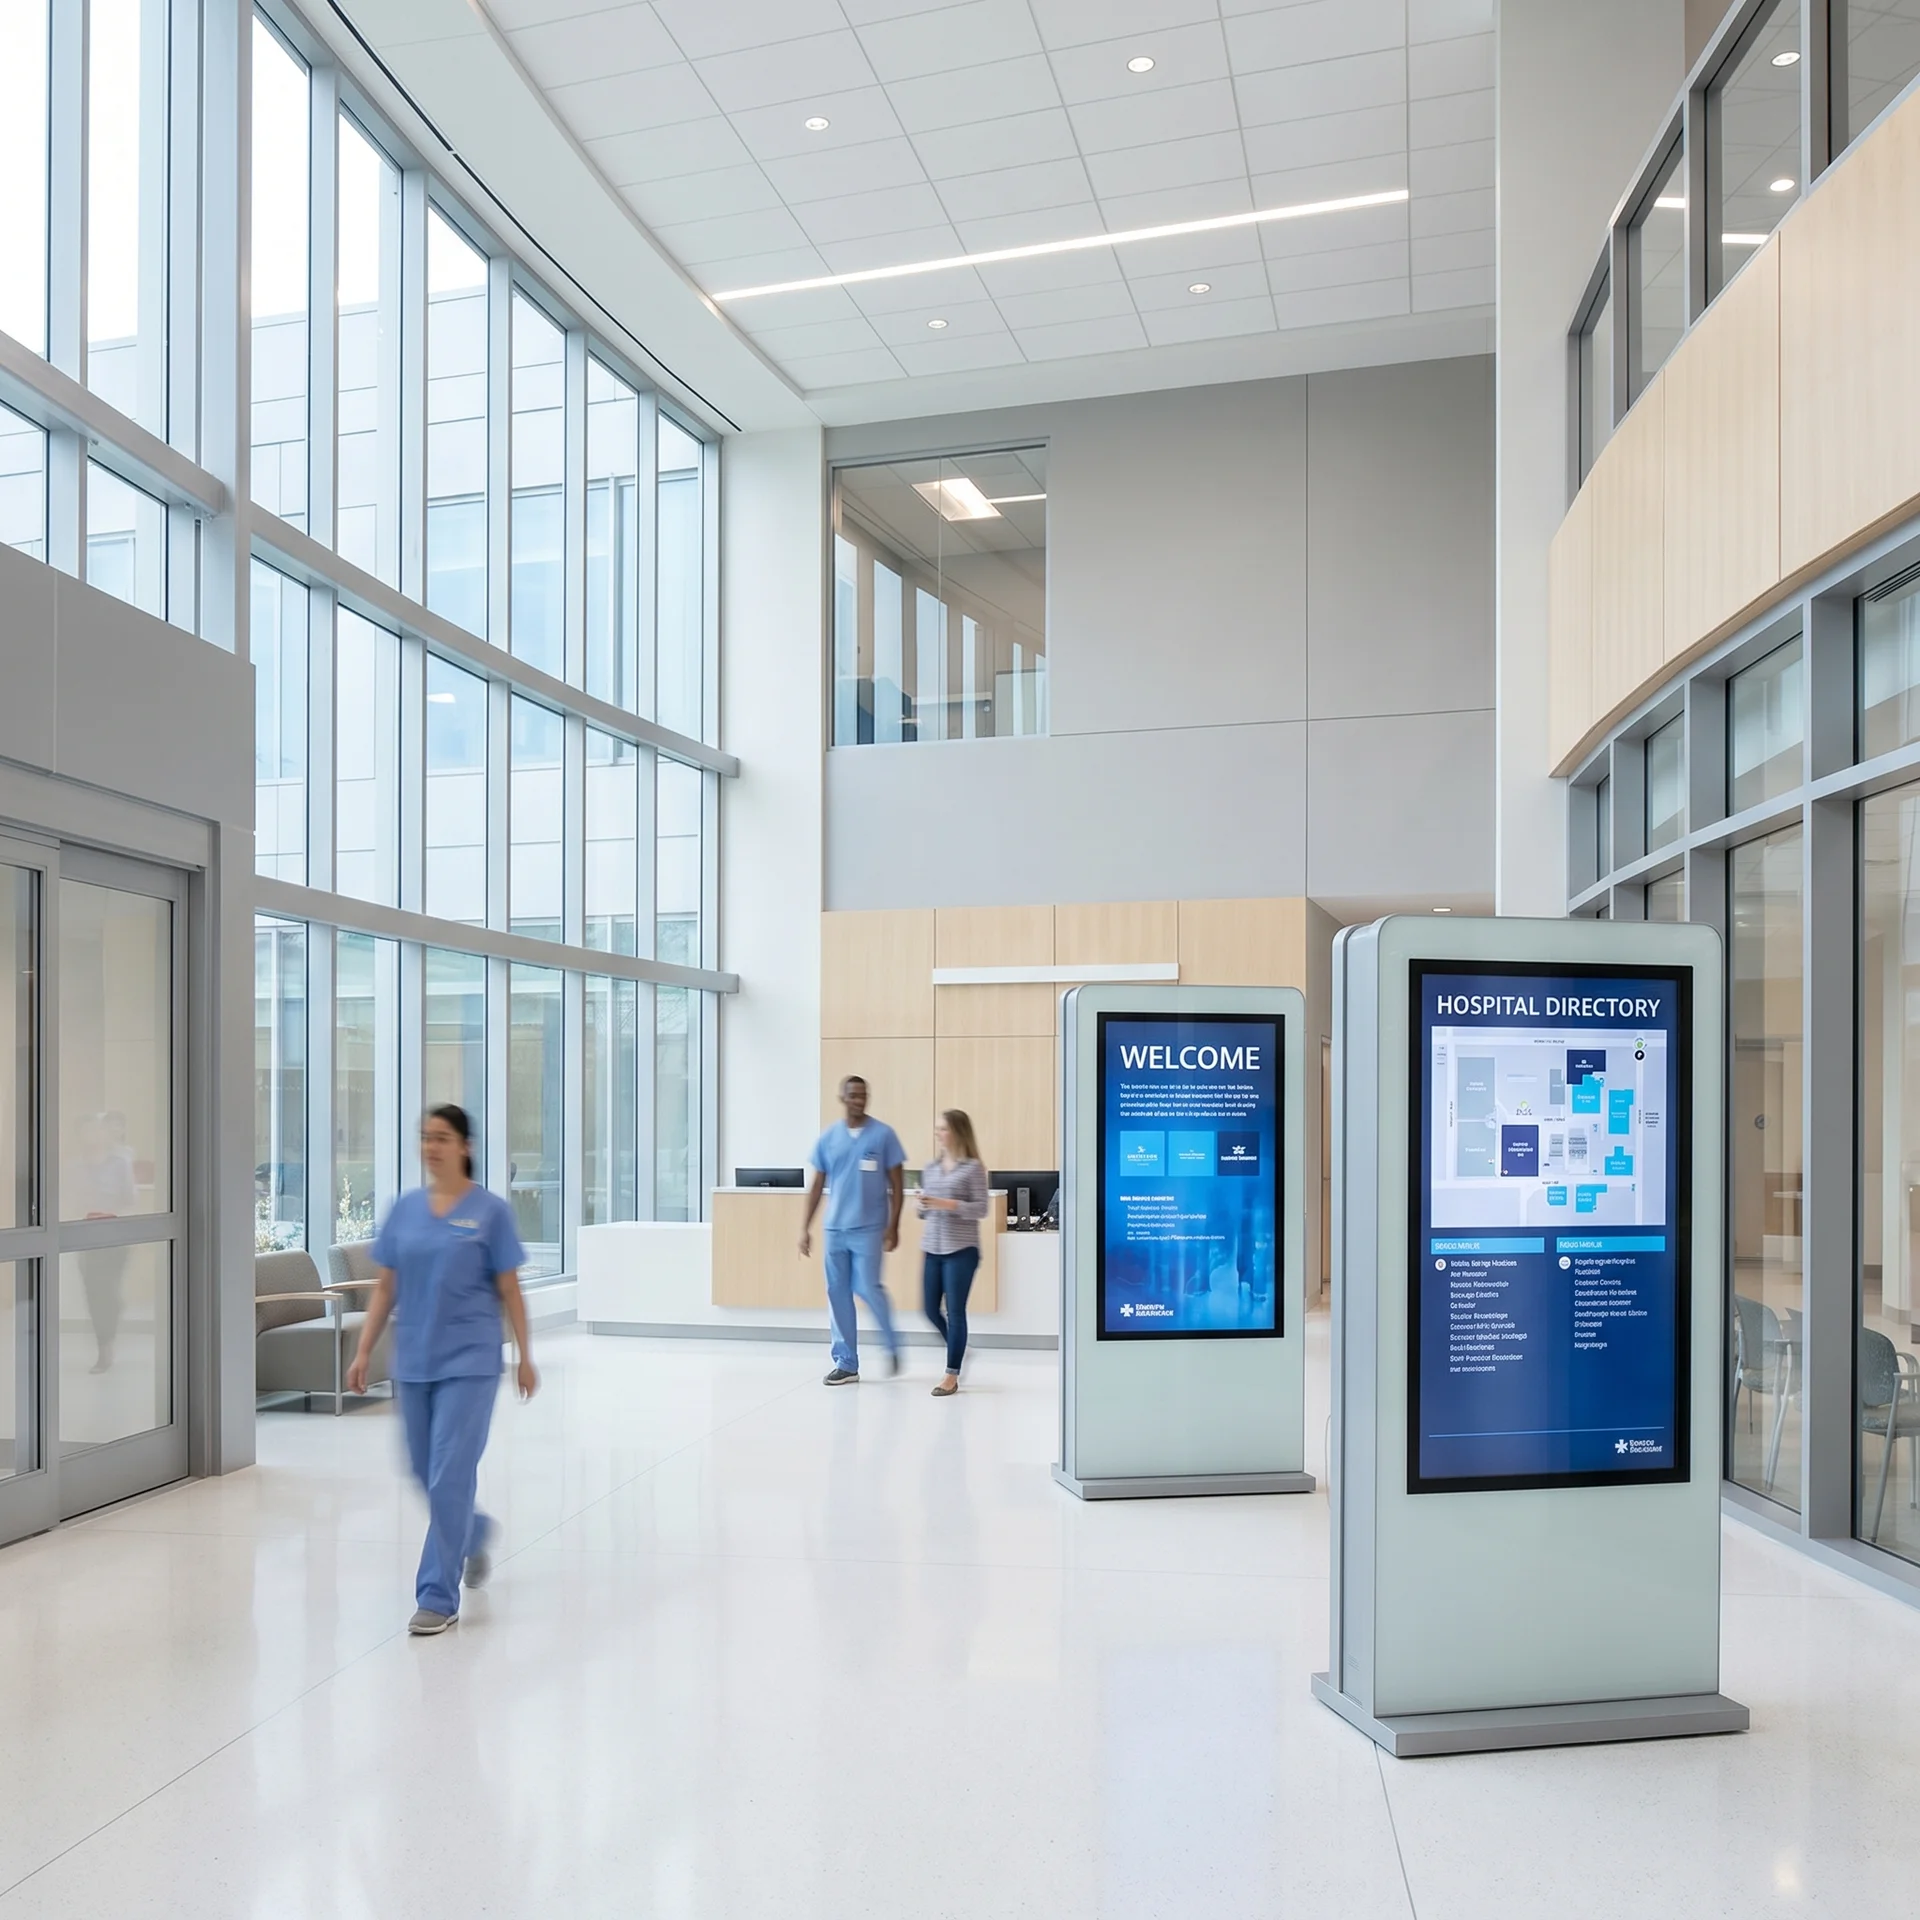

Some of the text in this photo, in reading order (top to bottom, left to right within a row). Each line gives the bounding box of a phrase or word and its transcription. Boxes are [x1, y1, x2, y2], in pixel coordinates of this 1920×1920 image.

[1437, 995, 1660, 1018] HOSPITAL DIRECTORY
[1120, 1045, 1260, 1070] WELCOME
